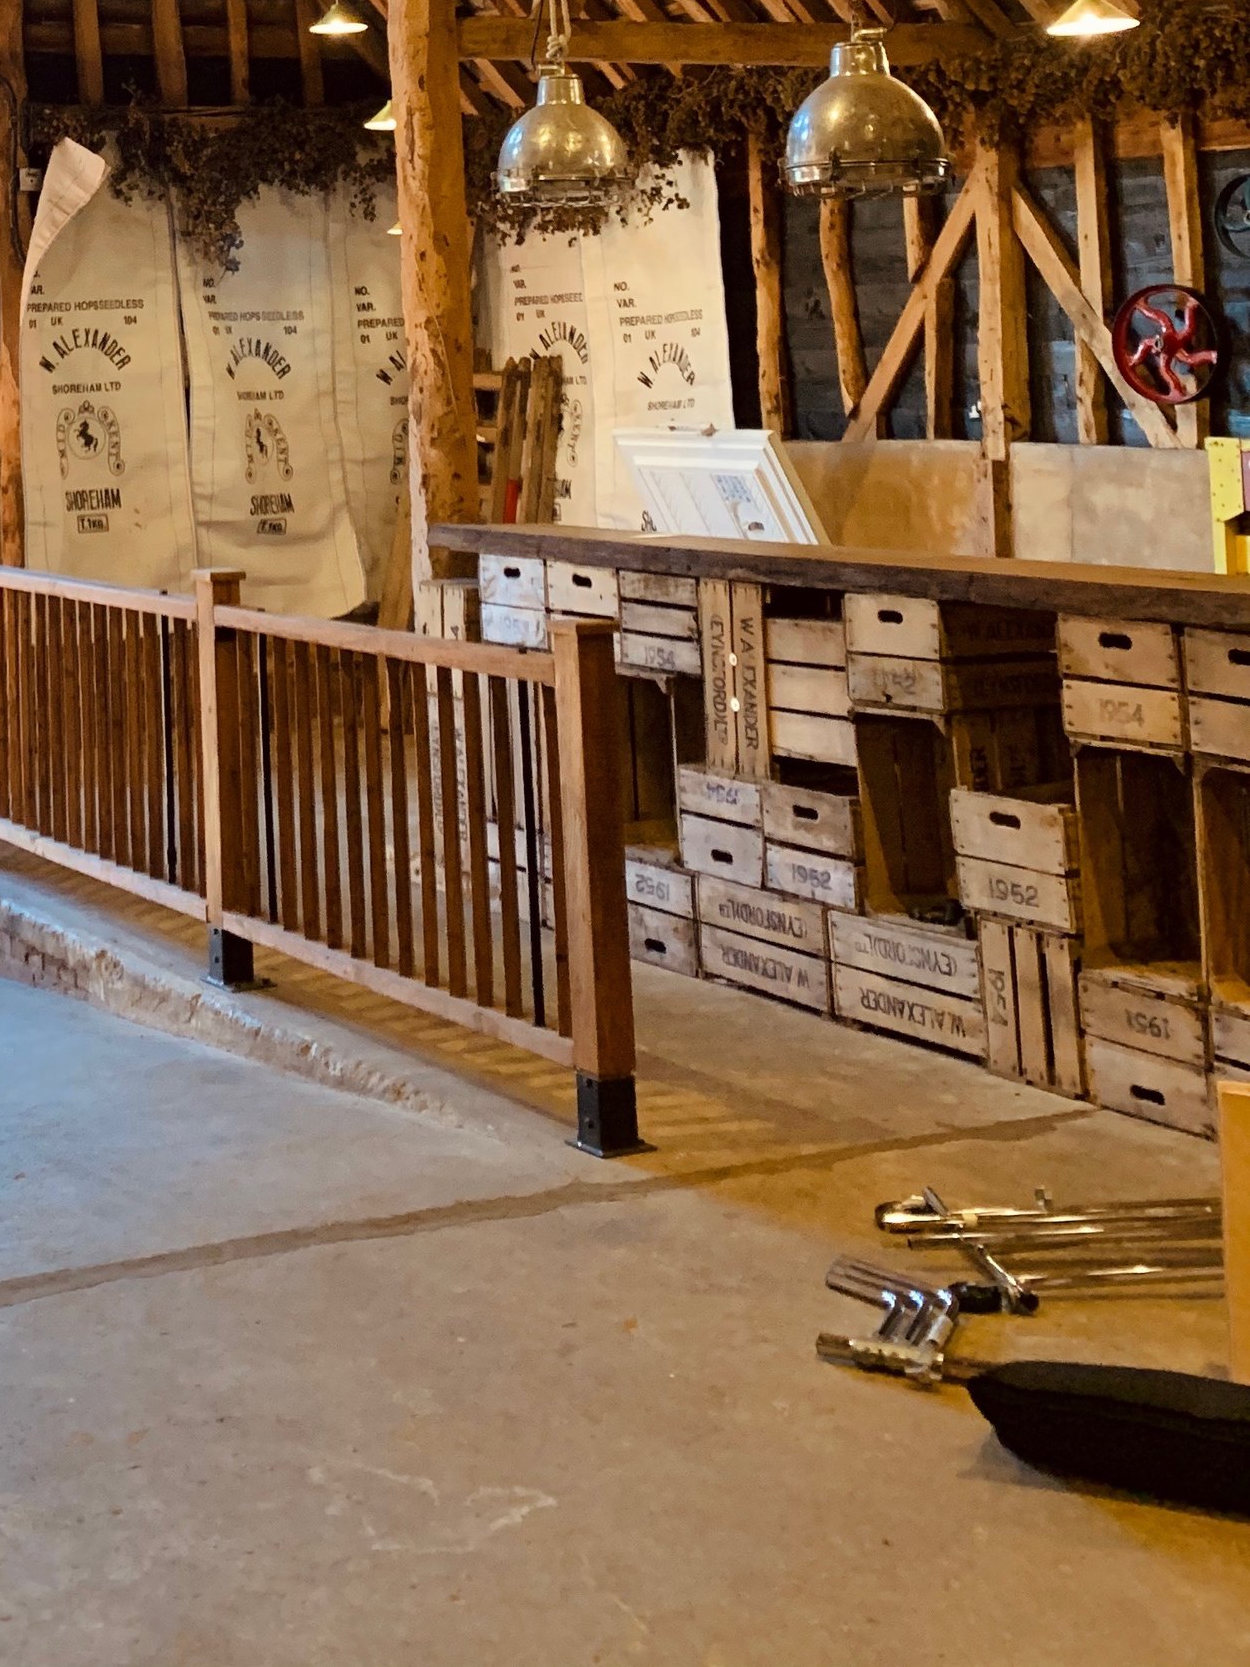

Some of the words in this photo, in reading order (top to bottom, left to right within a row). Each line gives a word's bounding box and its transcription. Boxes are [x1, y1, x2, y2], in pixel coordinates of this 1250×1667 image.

[30, 285, 45, 295] AR.
[354, 286, 370, 296] NO.
[613, 281, 630, 292] NO.
[514, 295, 549, 306] PREPARED
[616, 298, 637, 308] VAR.
[27, 302, 71, 313] PREPARED
[356, 302, 376, 312] VAR.
[51, 316, 63, 326] UK
[124, 315, 137, 325] 104
[357, 317, 405, 329] PREPARED
[619, 315, 663, 327] PREPARED
[283, 325, 297, 335] 104
[385, 331, 398, 341] UK
[644, 330, 656, 340] UK
[52, 327, 131, 371] ALEXANDER
[230, 337, 291, 380] ALEXANDER
[52, 383, 102, 395] SHOREHAM
[104, 381, 121, 392] LTD
[269, 390, 284, 400] LTD
[107, 419, 120, 459] KENT
[273, 427, 288, 464] KENT
[65, 488, 122, 512] SHOREHAM
[250, 492, 295, 516] SHOREHAM
[791, 862, 833, 891] 1952
[635, 874, 670, 901] 1952
[988, 877, 1040, 909] 1952
[721, 944, 794, 983] ALEXANDER
[859, 987, 946, 1031] ALEXANDER
